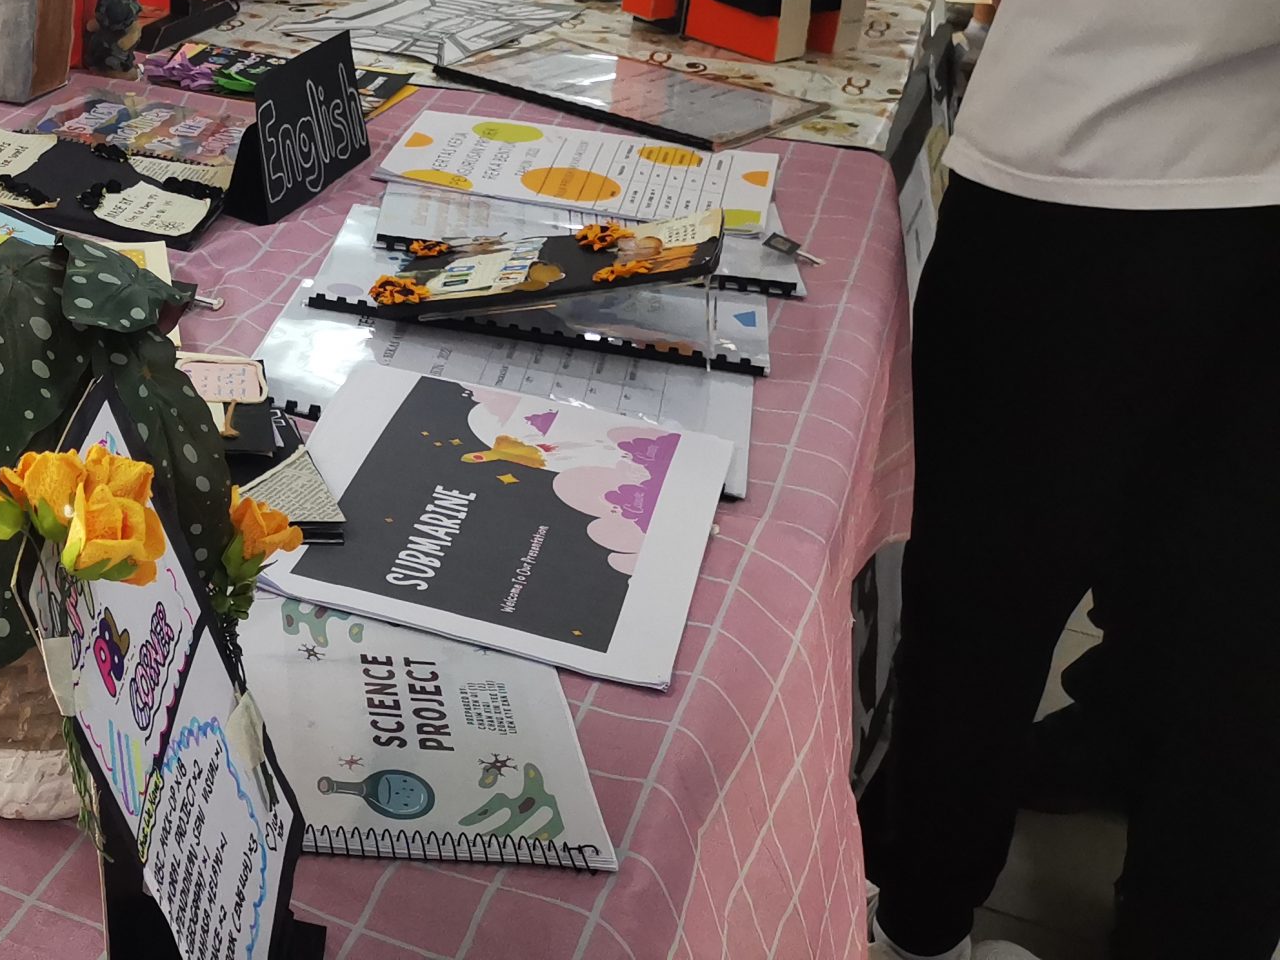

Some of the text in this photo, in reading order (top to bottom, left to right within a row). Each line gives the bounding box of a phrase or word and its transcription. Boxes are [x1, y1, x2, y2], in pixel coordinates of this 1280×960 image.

[258, 62, 367, 204] English
[385, 484, 477, 590] SUBMARINE
[516, 562, 532, 577] Our
[520, 525, 550, 564] Presentation
[500, 583, 523, 613] Welcome
[130, 600, 175, 731] CORNER
[360, 654, 408, 749] SCIENCE
[403, 657, 455, 751] PROJECT
[461, 696, 475, 726] PREPARED
[167, 853, 181, 909] MORAL
[174, 779, 196, 854] PROJECT
[193, 804, 206, 847] SENI
[202, 757, 219, 804] VISUAL
[207, 846, 223, 914] MELAYU
